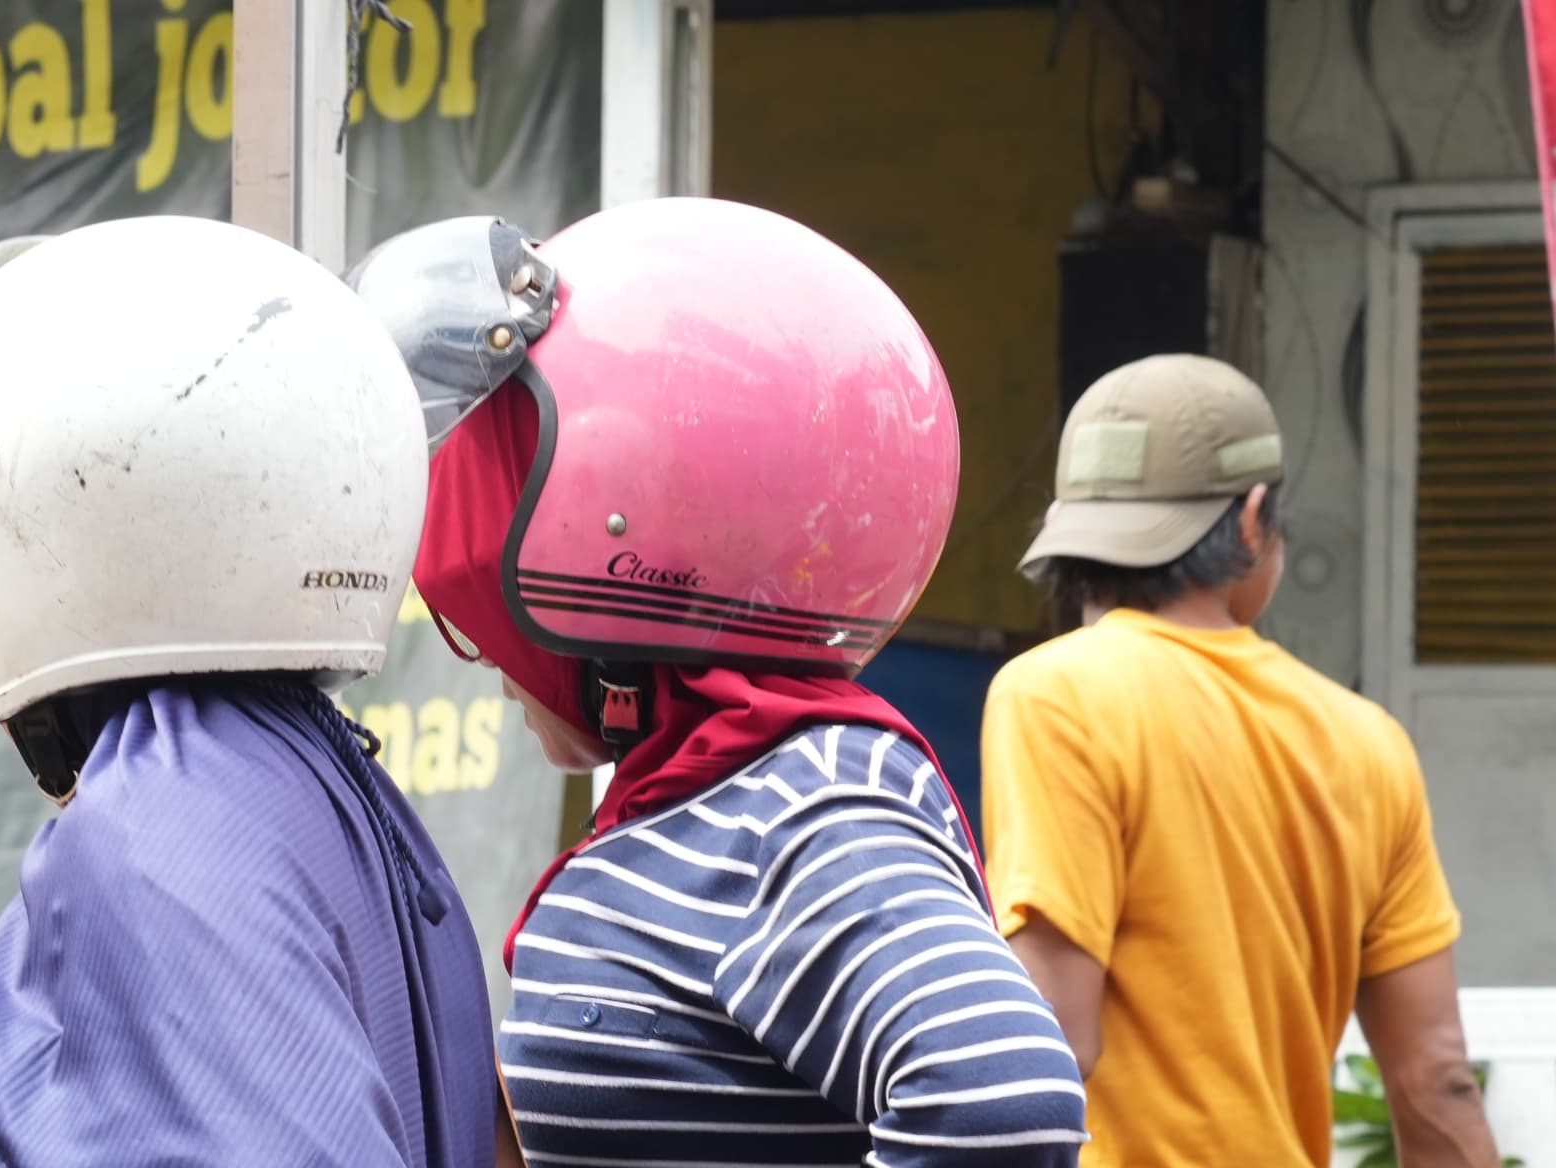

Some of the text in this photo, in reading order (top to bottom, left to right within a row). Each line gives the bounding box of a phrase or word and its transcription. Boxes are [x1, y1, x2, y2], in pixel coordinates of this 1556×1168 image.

[137, 0, 486, 192] joor
[301, 570, 388, 593] HONDA
[606, 551, 709, 590] Classic
